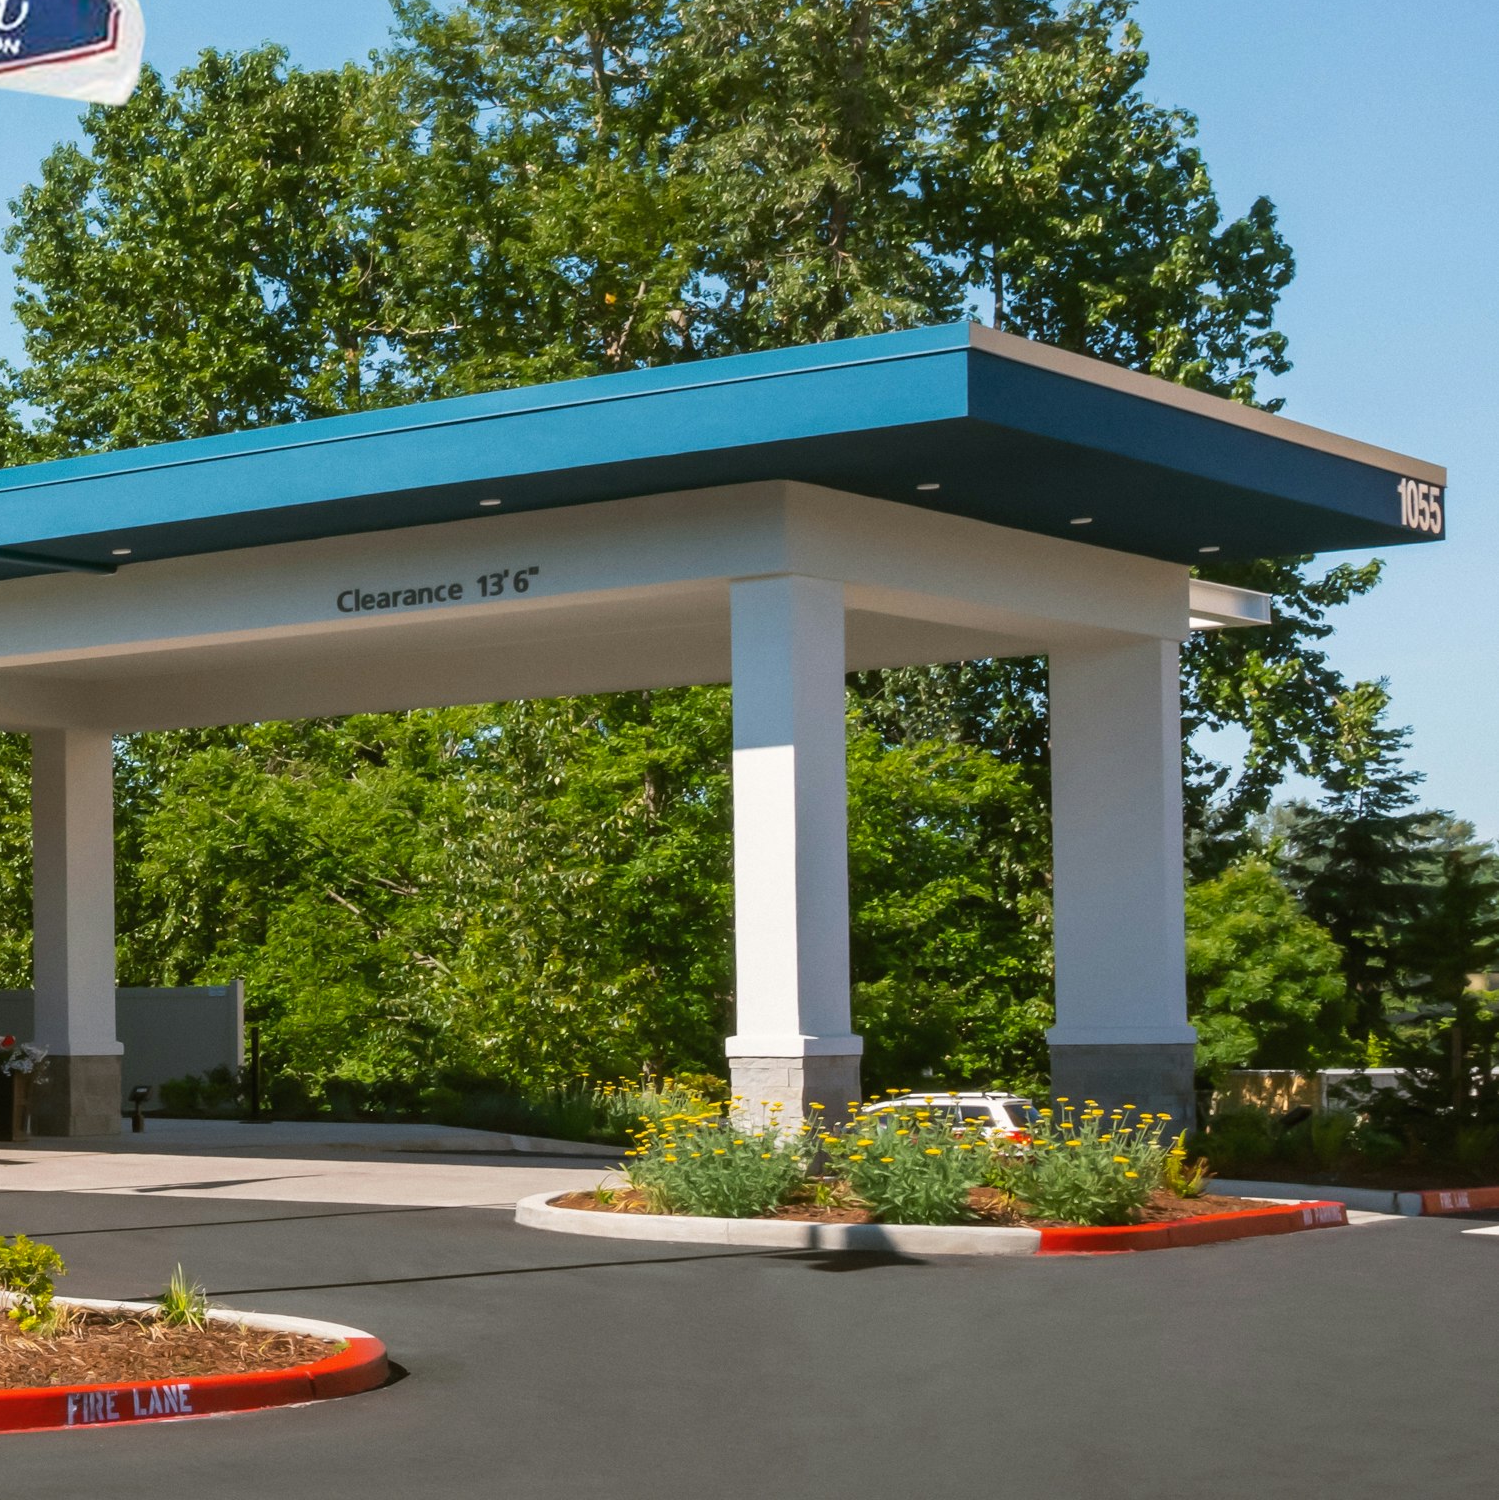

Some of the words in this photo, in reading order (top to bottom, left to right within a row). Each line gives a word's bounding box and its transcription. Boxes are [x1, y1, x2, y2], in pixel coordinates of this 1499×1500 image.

[1397, 478, 1441, 534] 1055
[336, 582, 463, 613] Clearance
[67, 1390, 120, 1425] FIRE
[132, 1383, 193, 1416] LANE
